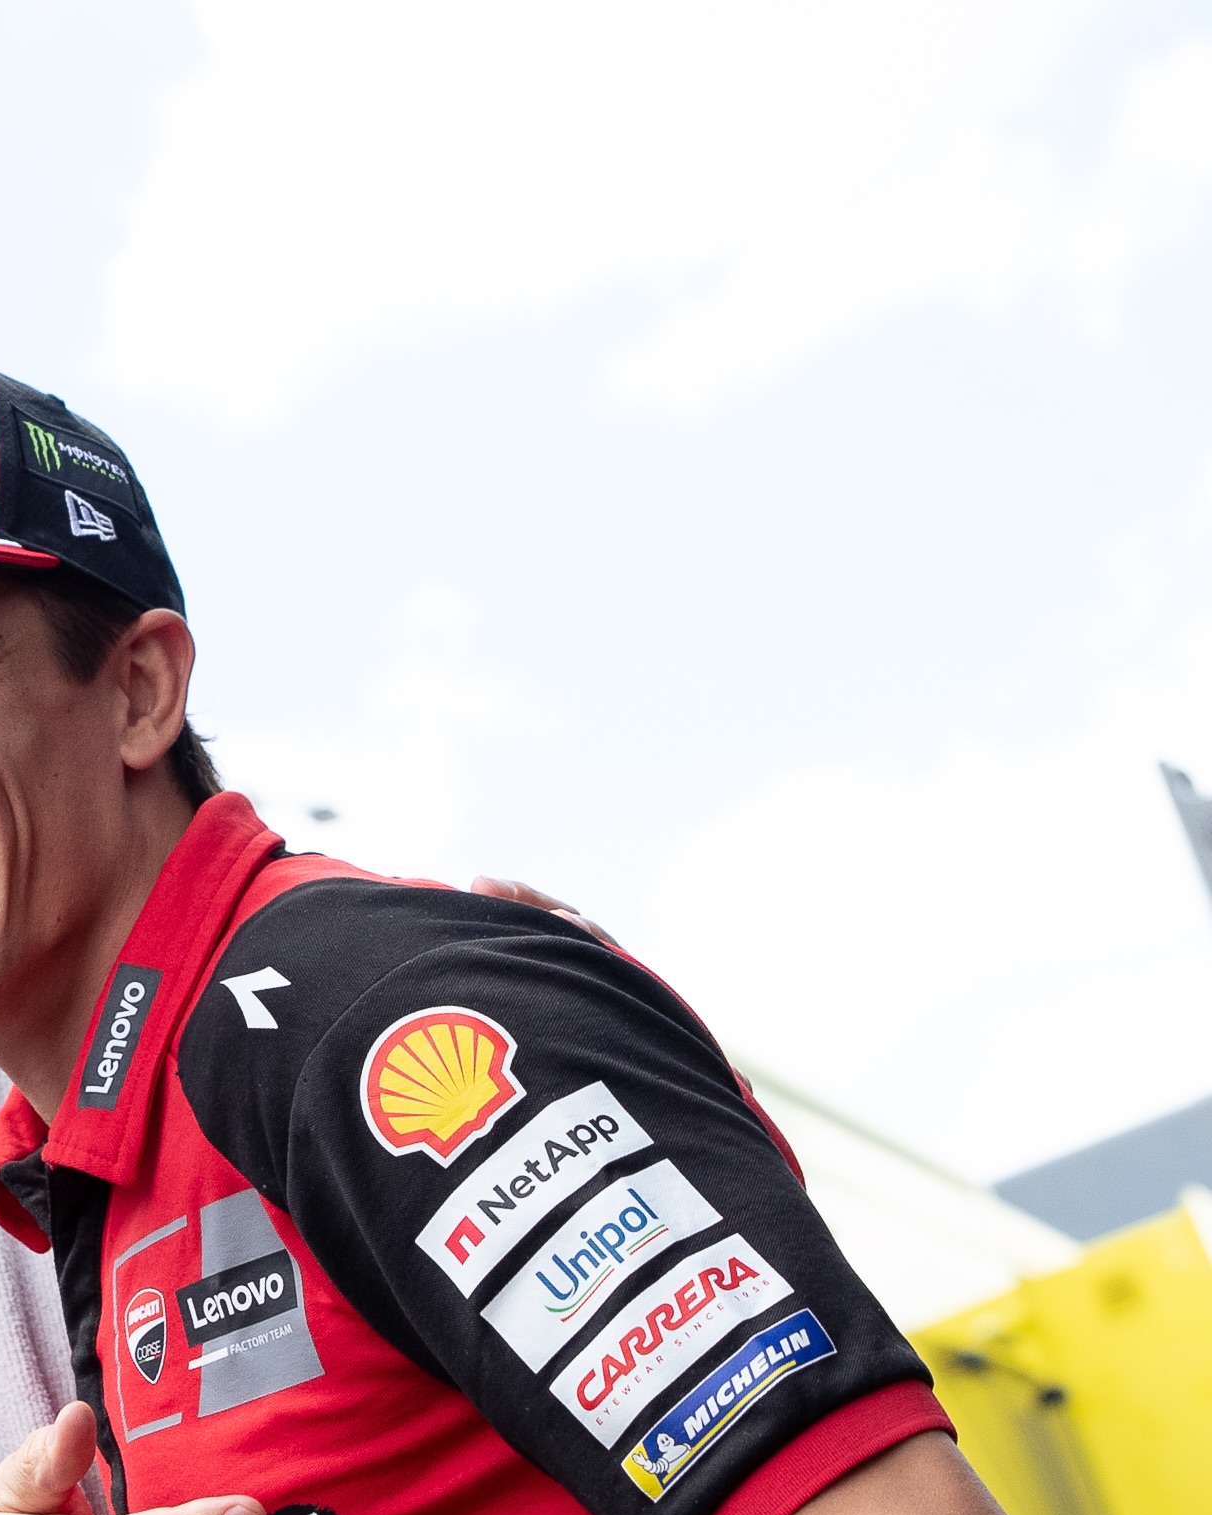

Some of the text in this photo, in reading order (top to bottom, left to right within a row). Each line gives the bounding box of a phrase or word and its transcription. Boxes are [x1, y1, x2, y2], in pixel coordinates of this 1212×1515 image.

[85, 981, 146, 1096] Lenovo
[476, 1114, 620, 1226] NetApp
[535, 1188, 659, 1300] Unipol
[128, 1298, 160, 1327] DUCATI
[136, 1339, 162, 1361] CORSE
[187, 1272, 285, 1330] Lenovo
[229, 1323, 294, 1355] FACTORY TEAM
[576, 1257, 761, 1412] CARRERA
[596, 1279, 771, 1426] EYEWEAR SINCE 1956
[682, 1328, 811, 1441] MICHELIN
